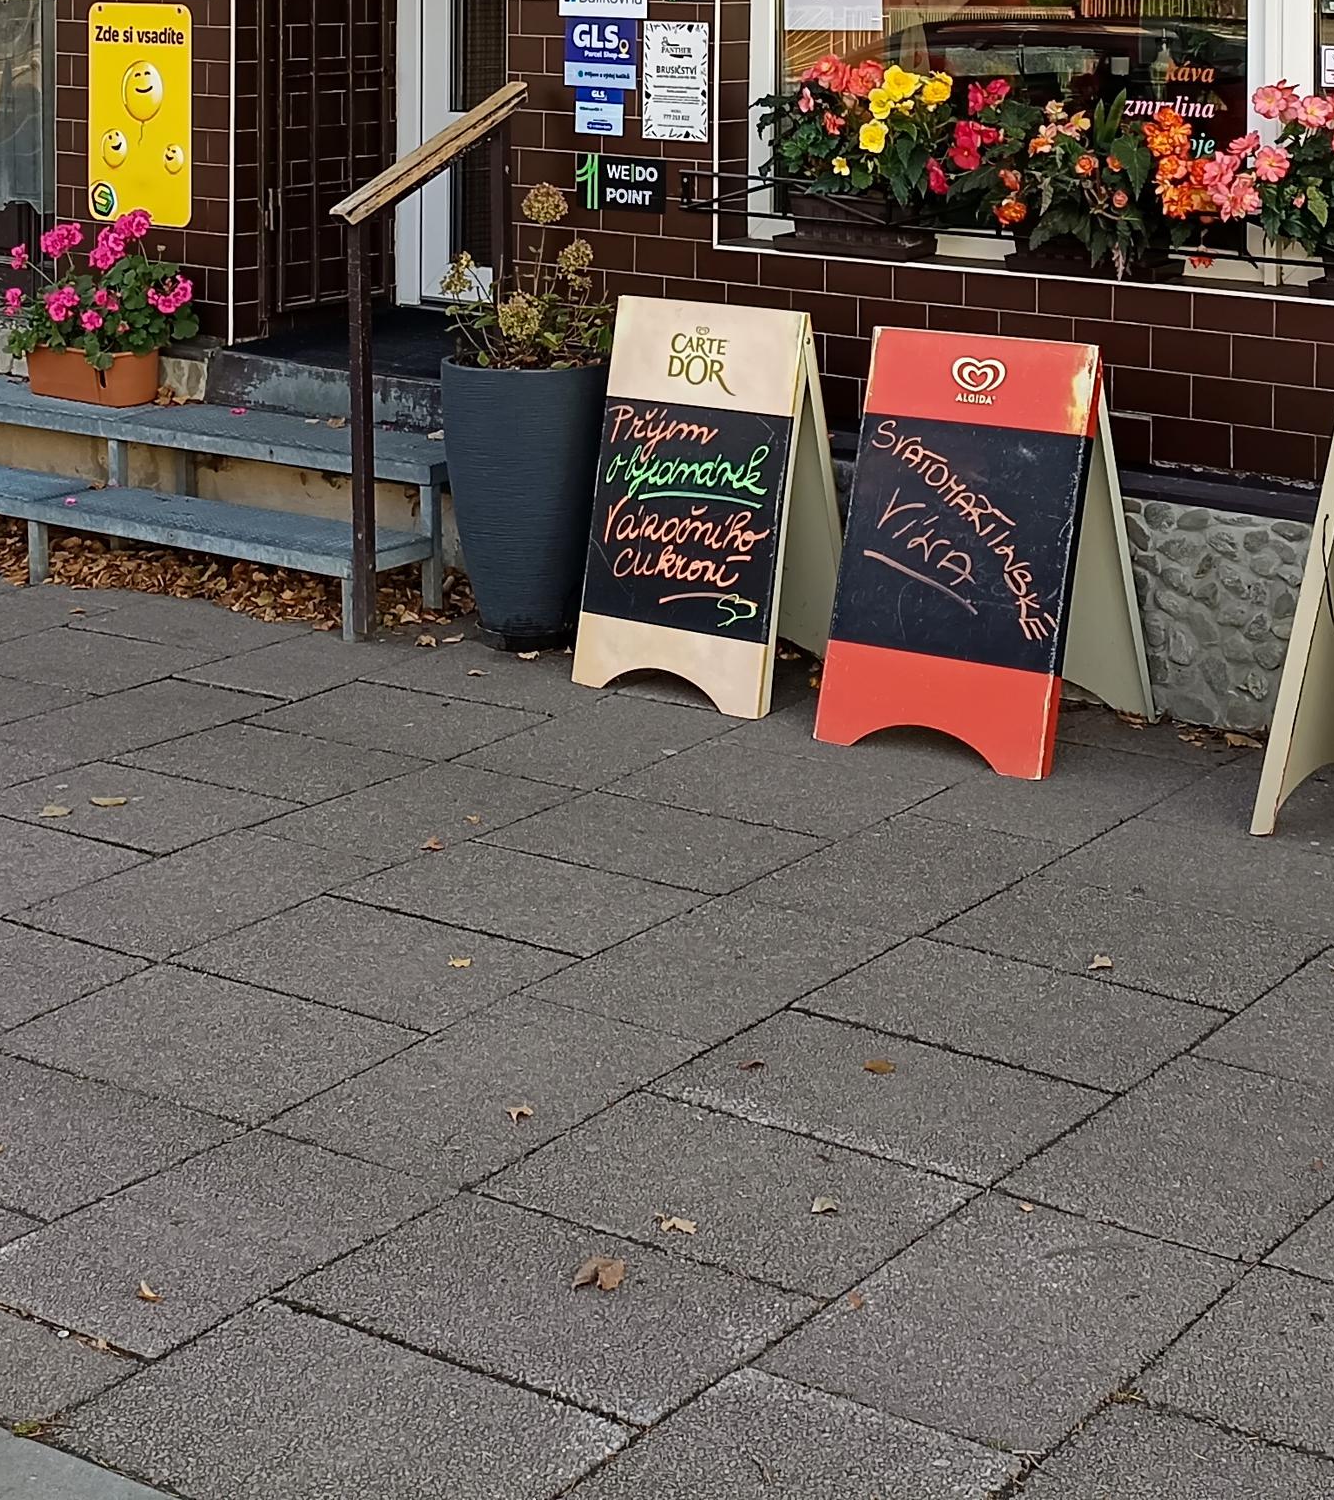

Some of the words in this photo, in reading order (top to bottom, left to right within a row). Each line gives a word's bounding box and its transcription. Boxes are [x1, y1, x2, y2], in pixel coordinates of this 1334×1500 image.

[95, 25, 120, 43] Zde
[122, 27, 134, 44] si
[136, 26, 185, 45] vsadíte
[572, 23, 620, 50] GLS
[656, 65, 697, 75] BRUSIČSTVÍ
[590, 89, 605, 98] GLS
[606, 187, 653, 205] POINT
[671, 331, 728, 357] CARTE
[955, 392, 994, 405] ALGIDA
[876, 486, 978, 587] VÍNA
